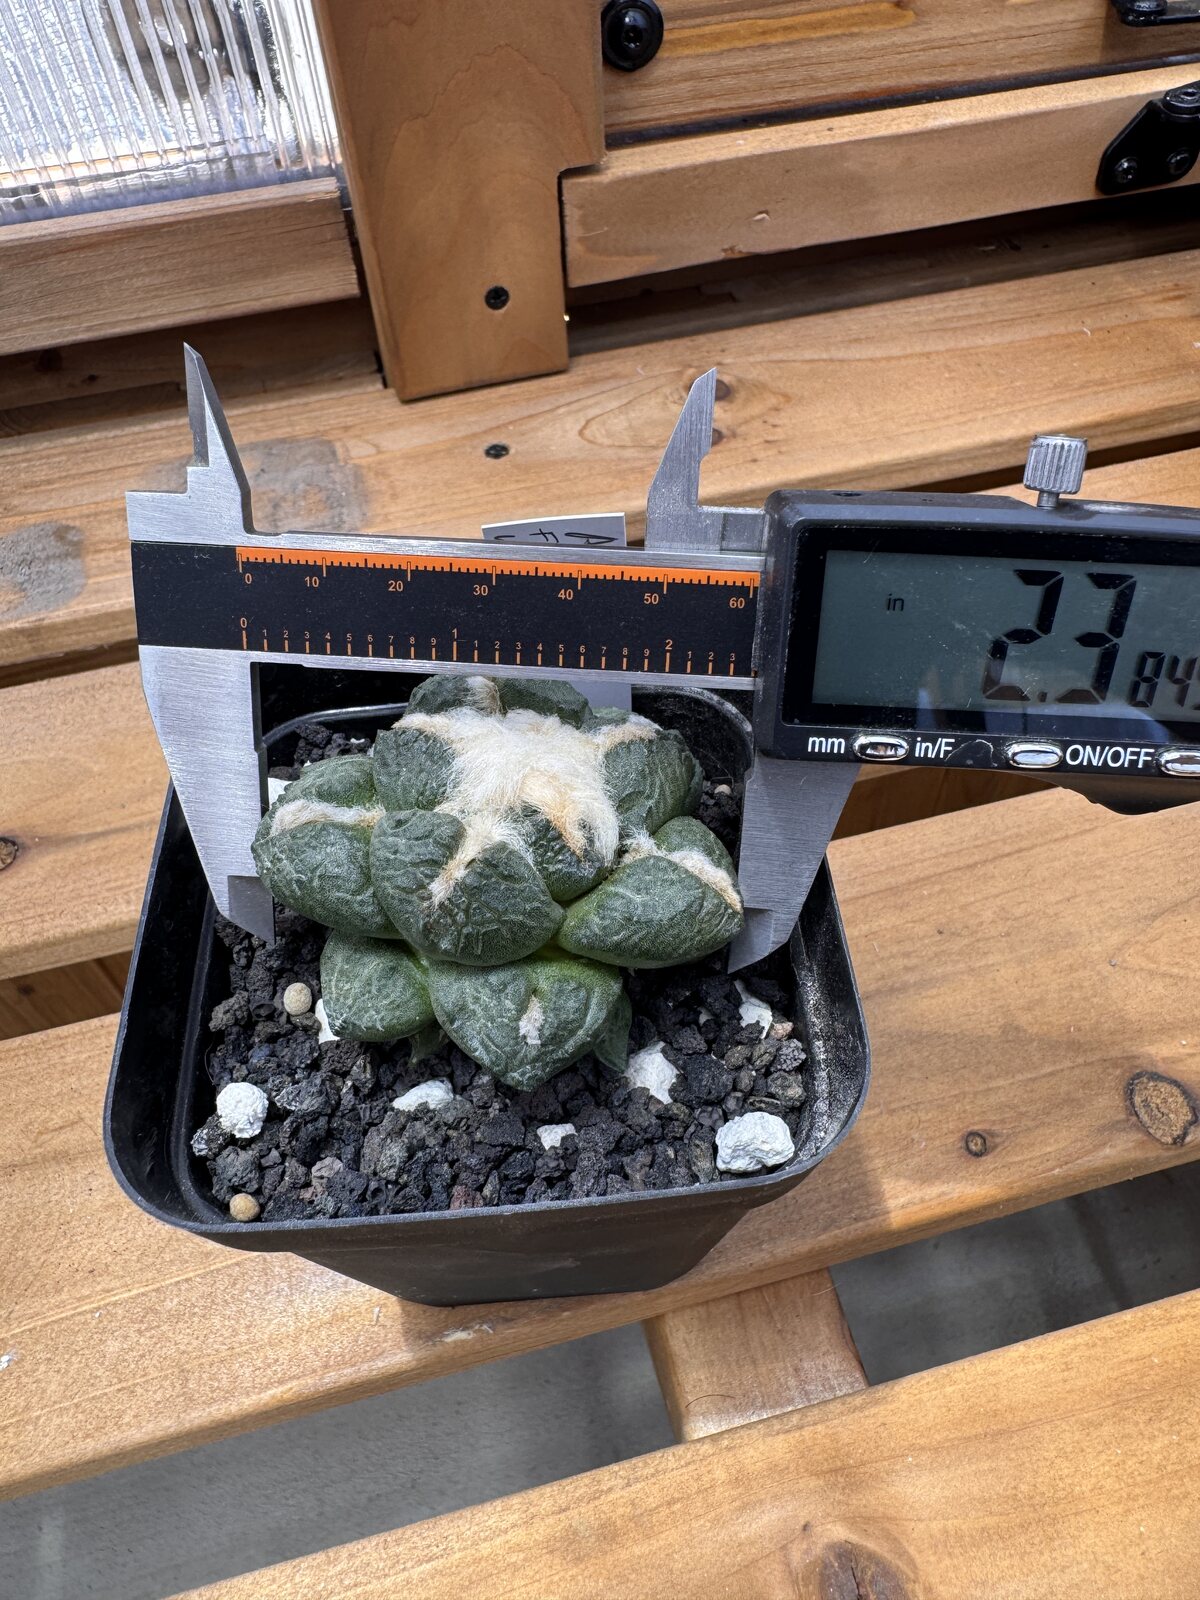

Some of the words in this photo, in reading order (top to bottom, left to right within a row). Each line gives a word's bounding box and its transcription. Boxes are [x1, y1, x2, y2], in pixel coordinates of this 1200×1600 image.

[245, 573, 252, 584] 0
[304, 577, 319, 587] 10
[388, 580, 403, 592] 20
[473, 585, 488, 595] 30
[558, 589, 573, 600] 40
[644, 593, 659, 604] 50
[729, 598, 745, 608] 60
[886, 593, 905, 612] in
[240, 618, 248, 628] 0
[452, 628, 458, 639] 1
[665, 640, 672, 649] 2
[982, 569, 1200, 708] 2.384
[808, 737, 845, 754] mm
[915, 737, 955, 760] in/F
[1065, 745, 1154, 769] ON/OFF
